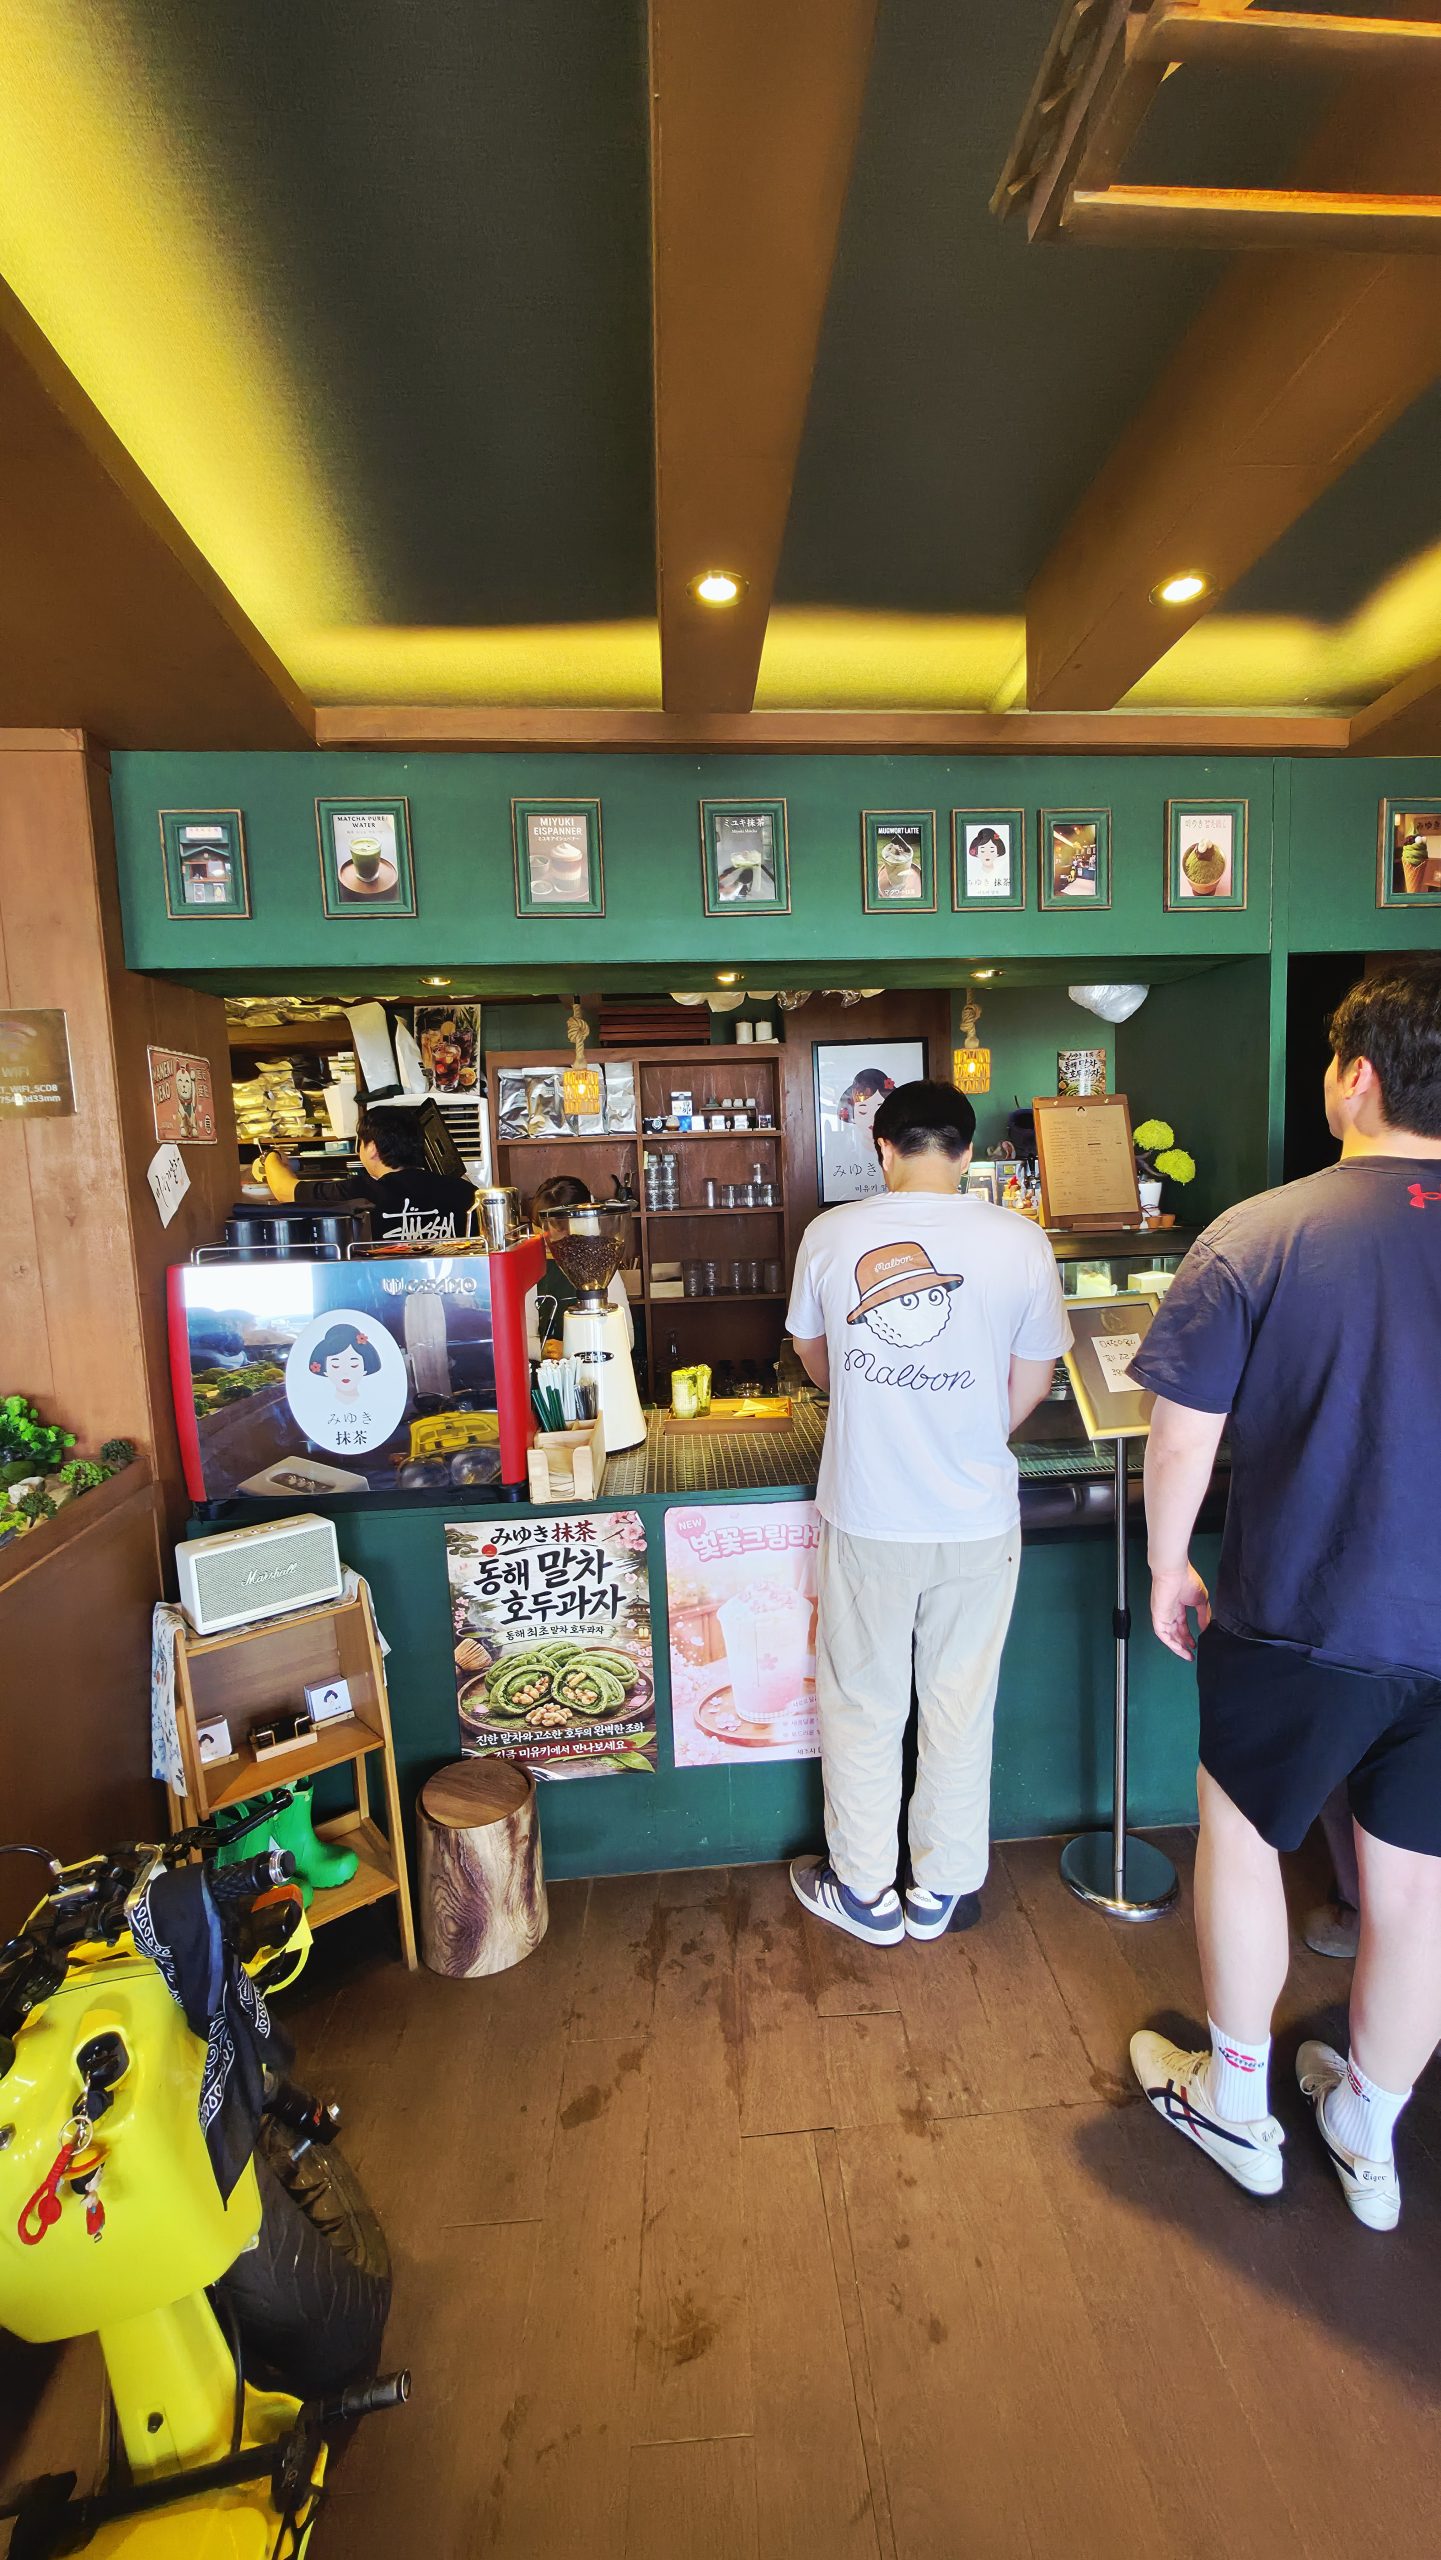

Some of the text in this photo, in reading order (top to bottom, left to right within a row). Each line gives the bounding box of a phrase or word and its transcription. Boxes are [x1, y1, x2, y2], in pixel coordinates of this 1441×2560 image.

[540, 817, 574, 827] MIYUKI
[533, 827, 582, 836] EISPANNER
[833, 1162, 877, 1177] みゆき
[874, 1255, 914, 1273] Malbon
[844, 1348, 976, 1392] Malbon
[328, 1411, 372, 1425] みゆき
[335, 1430, 368, 1446] 抹茶
[678, 1519, 702, 1531] NEW
[241, 1562, 298, 1587] Marshall
[474, 1547, 614, 1596] 동해 말차
[500, 1584, 627, 1625] 호두과자
[505, 1624, 605, 1641] 동해 최초 말차 호두과자
[476, 1722, 646, 1747] 진한 말차와 고소한 호두의 완벽한 조화
[518, 1745, 570, 1759] 미유키에서
[572, 1740, 628, 1755] 만나보세요
[1362, 2170, 1387, 2182] Tiger
